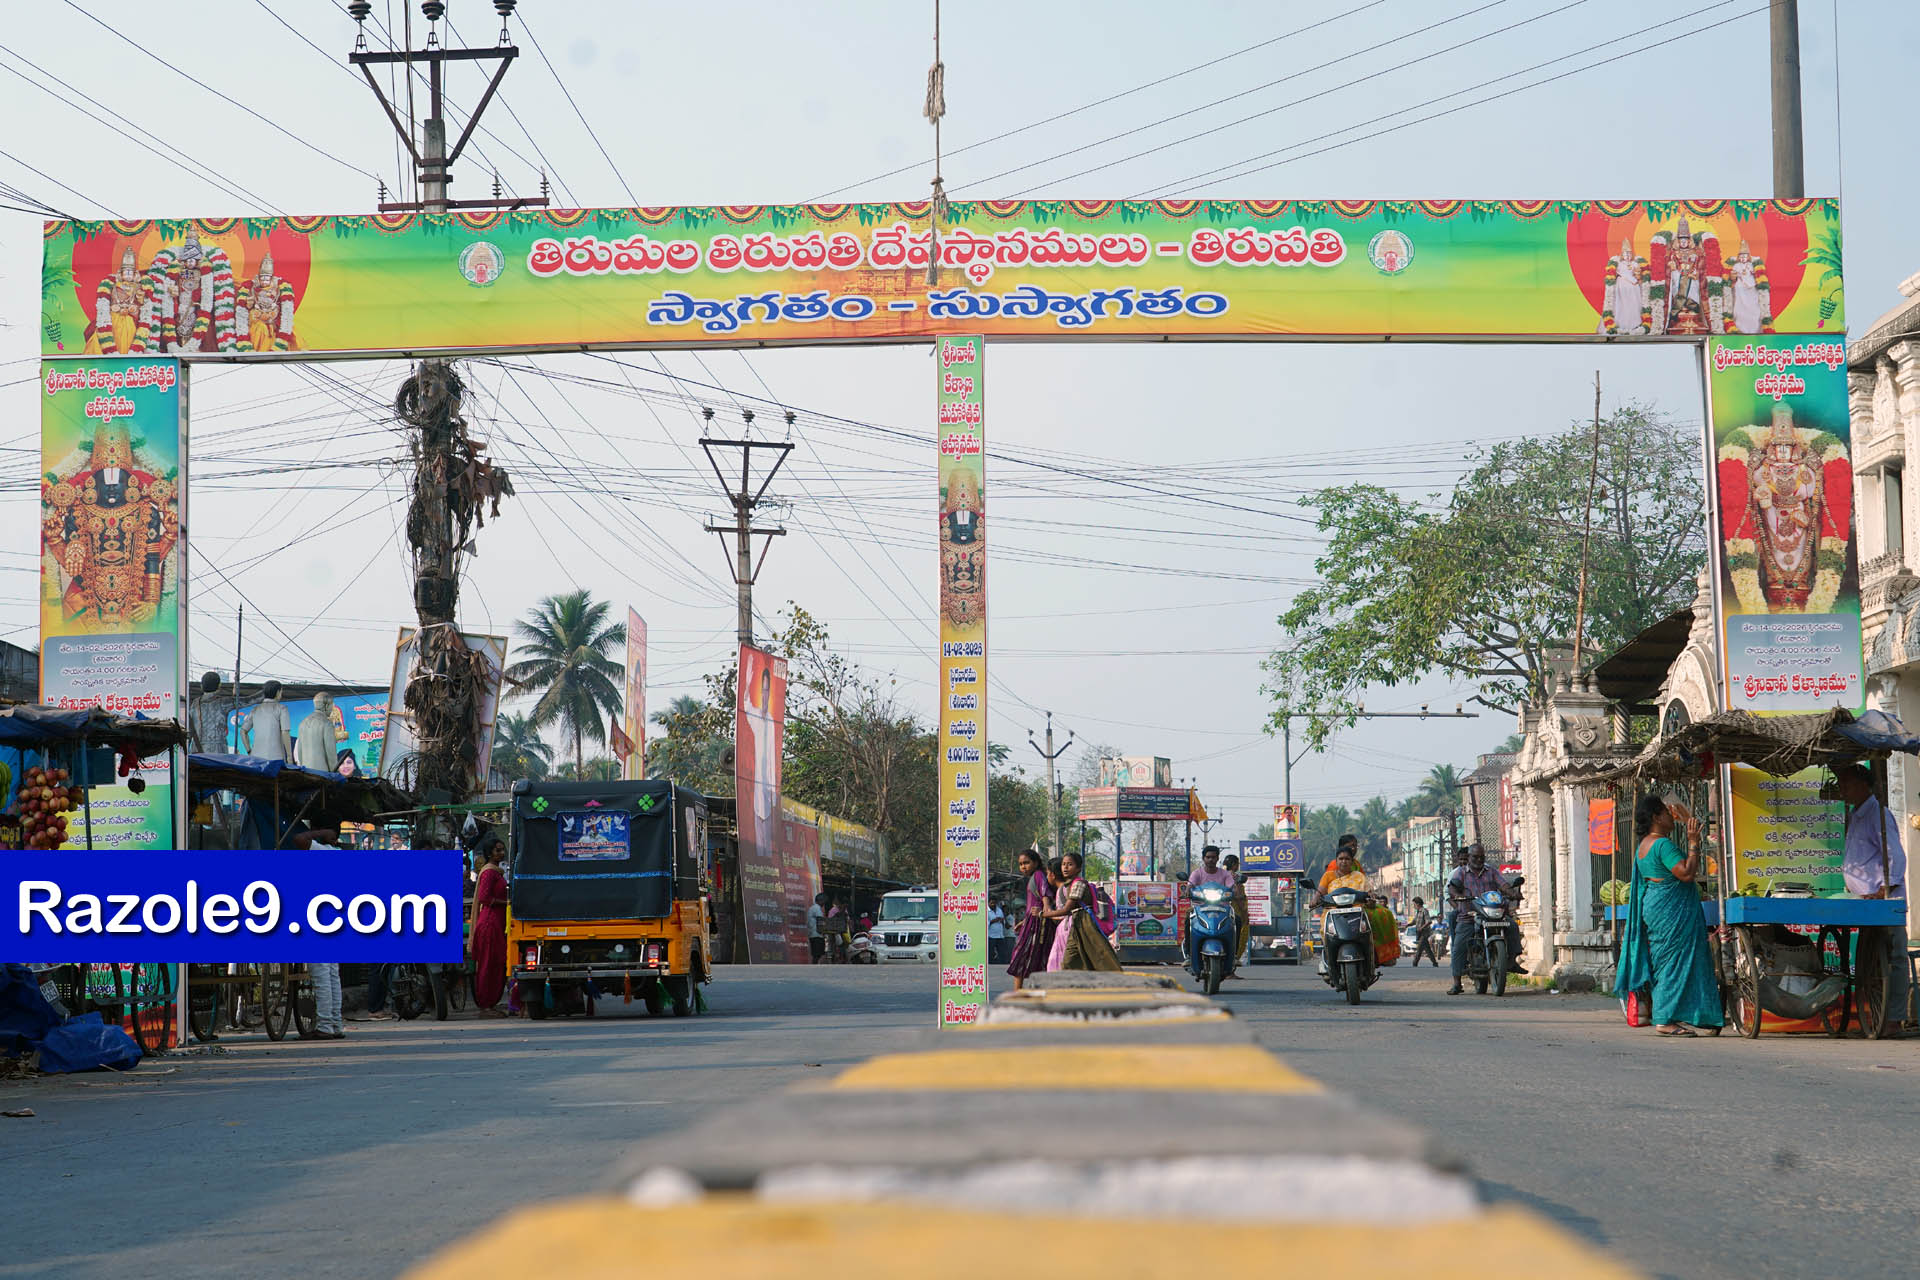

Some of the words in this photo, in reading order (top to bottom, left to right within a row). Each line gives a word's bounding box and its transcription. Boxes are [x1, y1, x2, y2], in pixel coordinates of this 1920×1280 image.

[528, 236, 700, 273] తిరుమల
[708, 233, 861, 270] తిరుపతి
[871, 225, 1147, 282] దేవస్థానములు
[1191, 230, 1344, 265] తిరుపతి
[648, 292, 874, 331] స్వాగతం
[930, 287, 1227, 325] సుస్వాగతం
[942, 341, 975, 368] శ్రీనివాస
[1714, 344, 1755, 369] శ్రీనివాస
[1794, 344, 1844, 370] మహోత్సవ
[45, 369, 86, 394] శ్రీనివాస
[126, 366, 175, 392] మహోత్సవ
[1755, 375, 1804, 400] ఆహ్వానము
[86, 397, 134, 422] ఆహ్వానము
[940, 402, 980, 430] మహోత్సవ
[1243, 846, 1270, 857] KCP
[1278, 848, 1295, 861] 65
